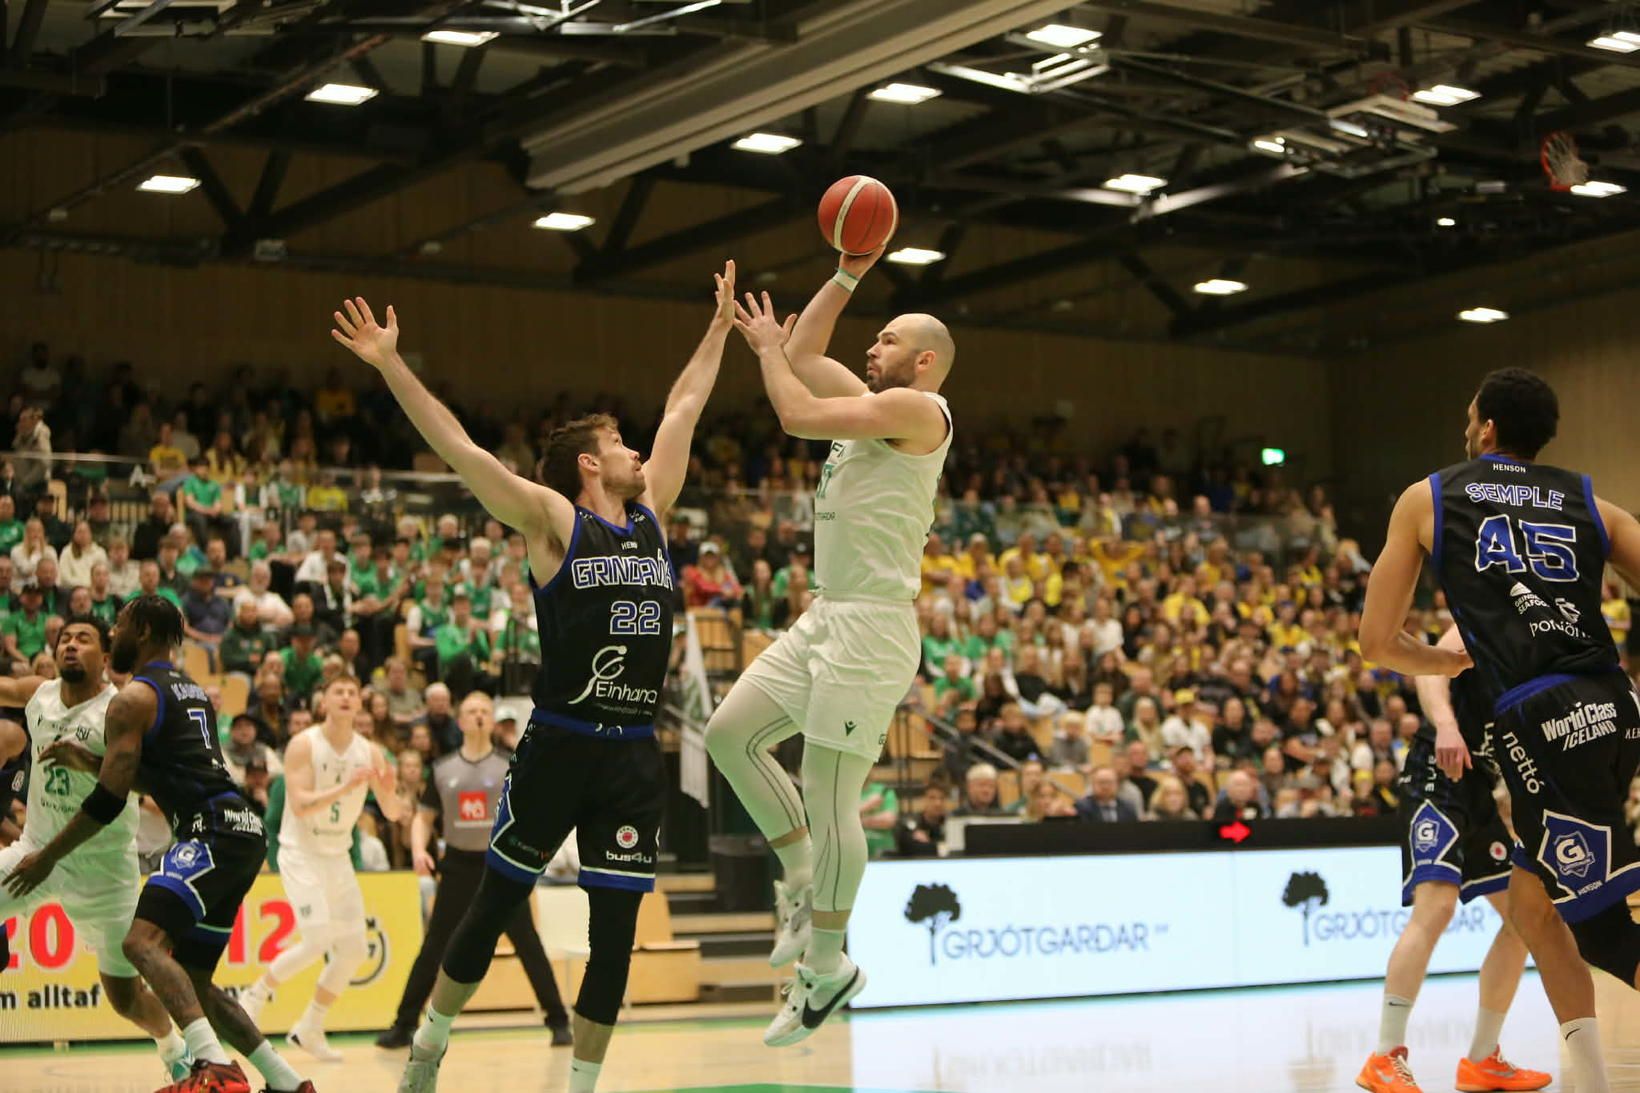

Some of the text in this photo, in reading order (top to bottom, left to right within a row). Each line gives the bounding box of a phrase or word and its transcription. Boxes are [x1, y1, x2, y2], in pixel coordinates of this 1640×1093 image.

[1492, 463, 1527, 473] HENSON
[1465, 482, 1565, 512] SEMPLE
[1474, 513, 1580, 582] 45
[609, 600, 661, 635] 22
[186, 708, 213, 750] 7
[1541, 702, 1618, 742] World Class
[1562, 720, 1618, 752] ICELAND
[1502, 731, 1546, 795] nettó
[43, 765, 72, 797] 23
[1416, 821, 1435, 842] G
[605, 851, 653, 865] bus4u
[1555, 838, 1587, 865] G
[27, 983, 100, 1009] alltaf
